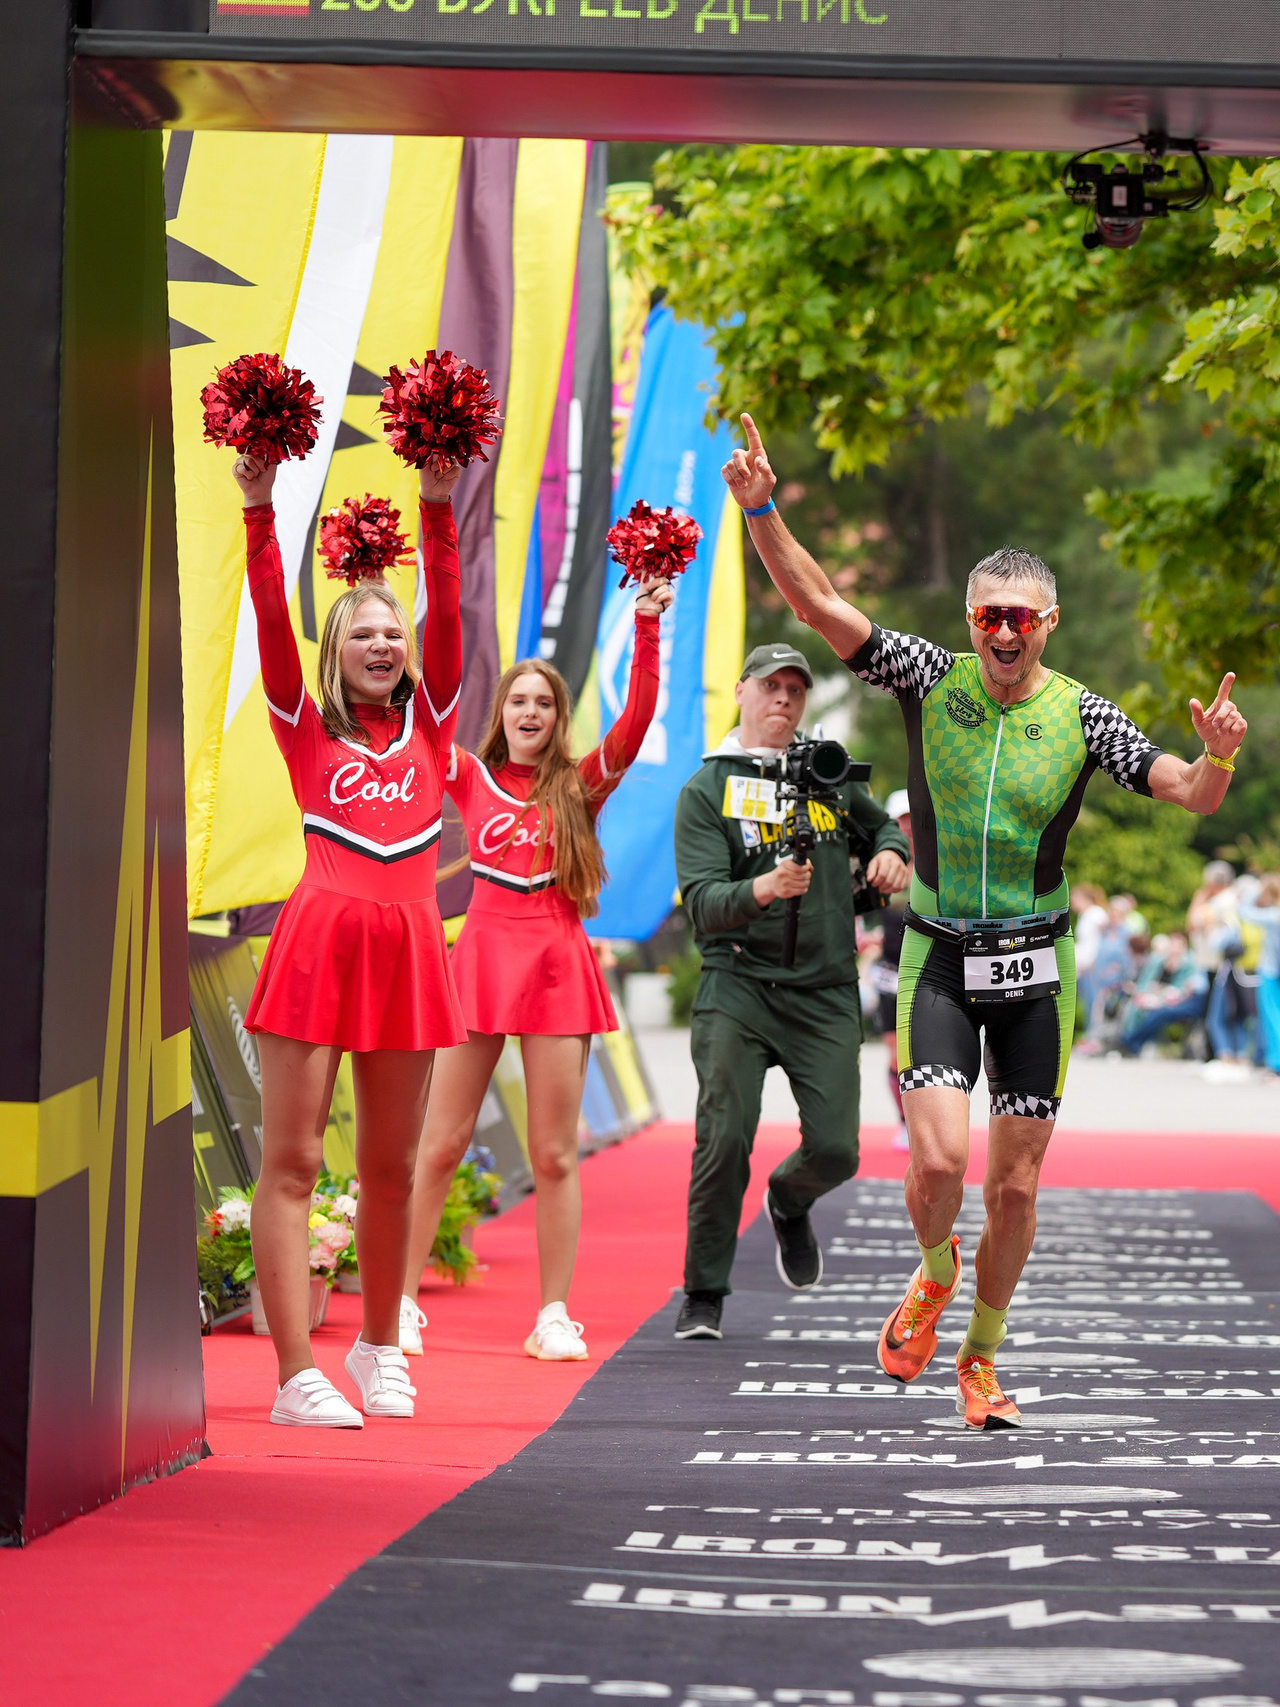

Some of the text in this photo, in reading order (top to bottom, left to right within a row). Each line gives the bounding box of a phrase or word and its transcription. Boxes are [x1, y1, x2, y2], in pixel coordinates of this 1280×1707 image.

[330, 762, 415, 804] Cool
[990, 957, 1034, 985] 349
[1005, 989, 1024, 998] DENIS
[695, 1451, 957, 1463] IRON
[624, 1531, 942, 1556] IRON
[583, 1583, 932, 1614] IRON
